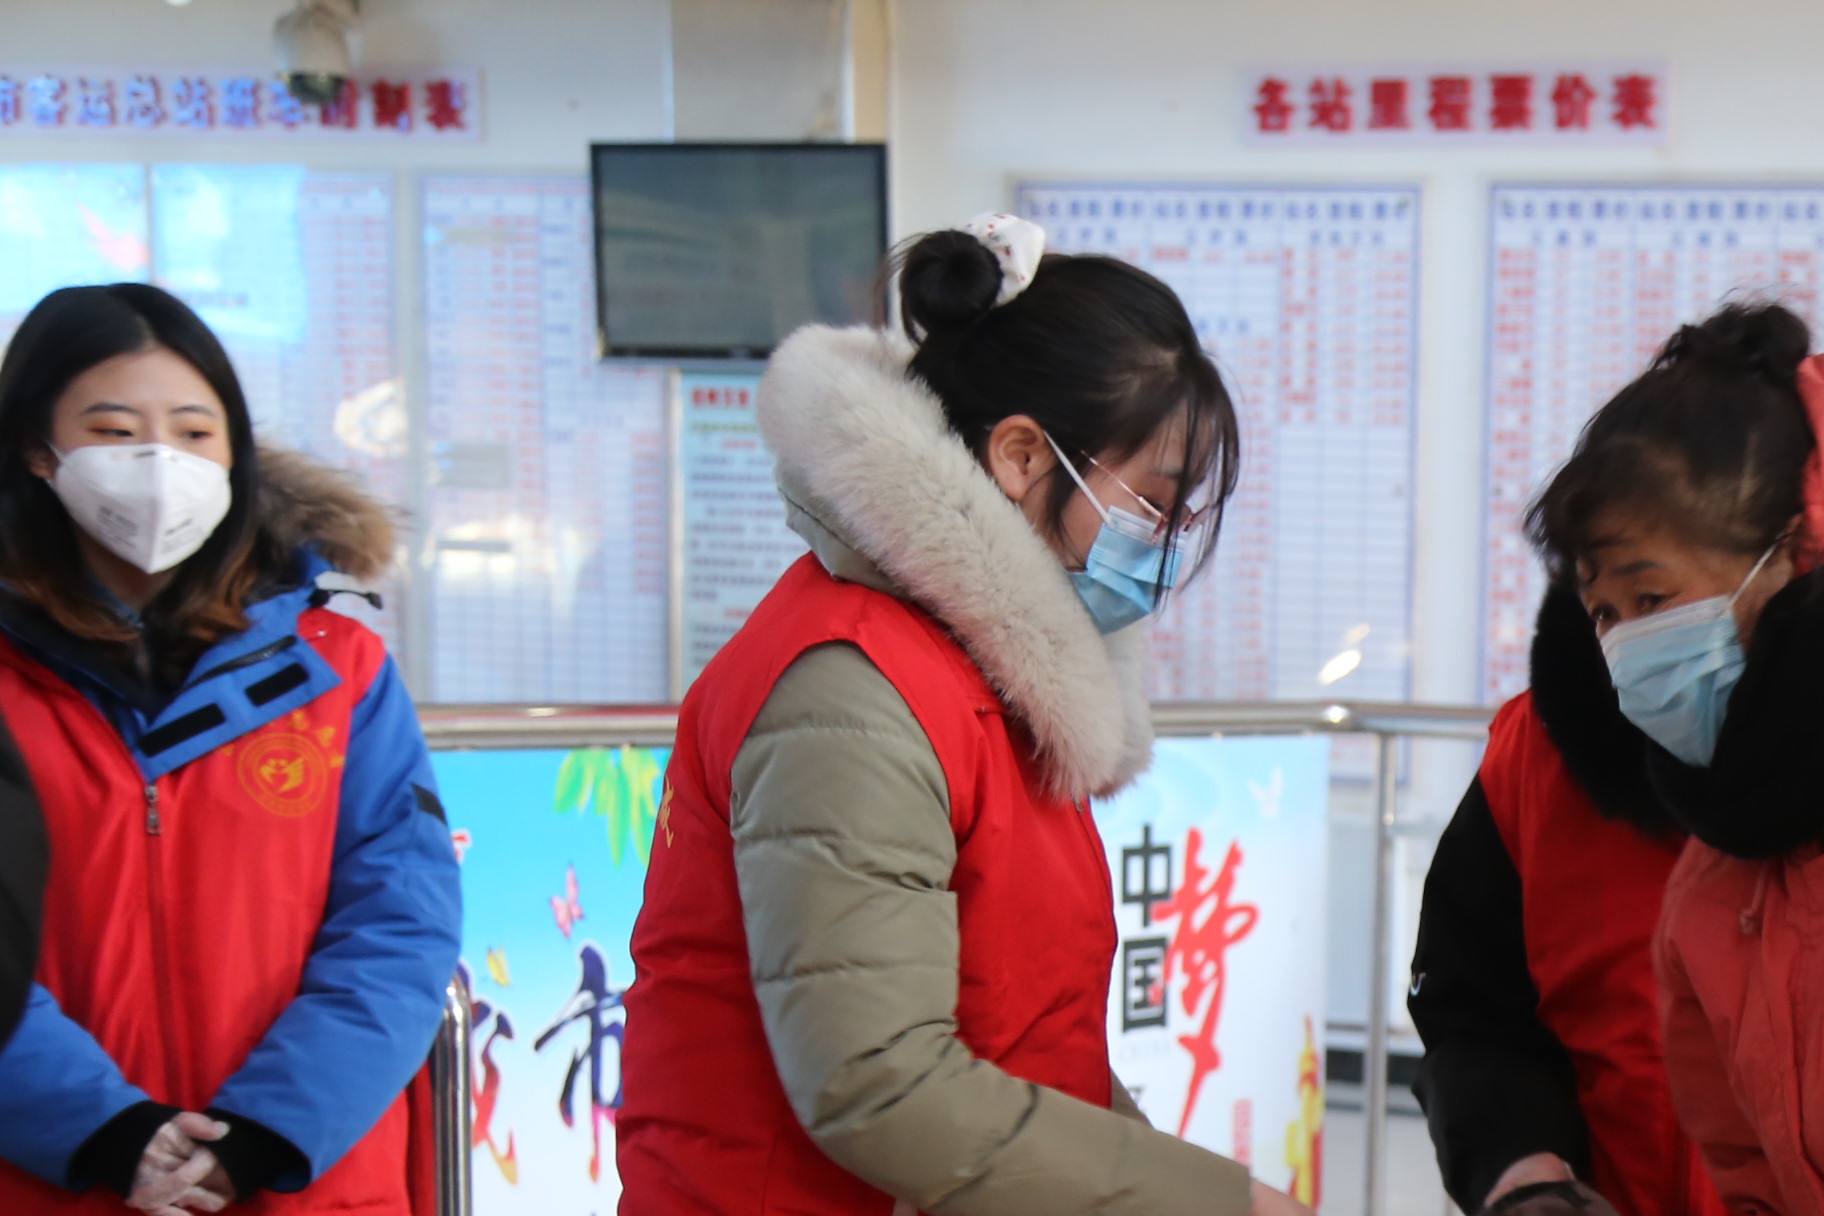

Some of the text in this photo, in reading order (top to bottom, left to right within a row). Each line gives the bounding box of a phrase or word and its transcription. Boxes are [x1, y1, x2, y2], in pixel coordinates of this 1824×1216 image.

[1253, 73, 1657, 134] 各站里程票价表
[1122, 824, 1172, 1032] 中国
